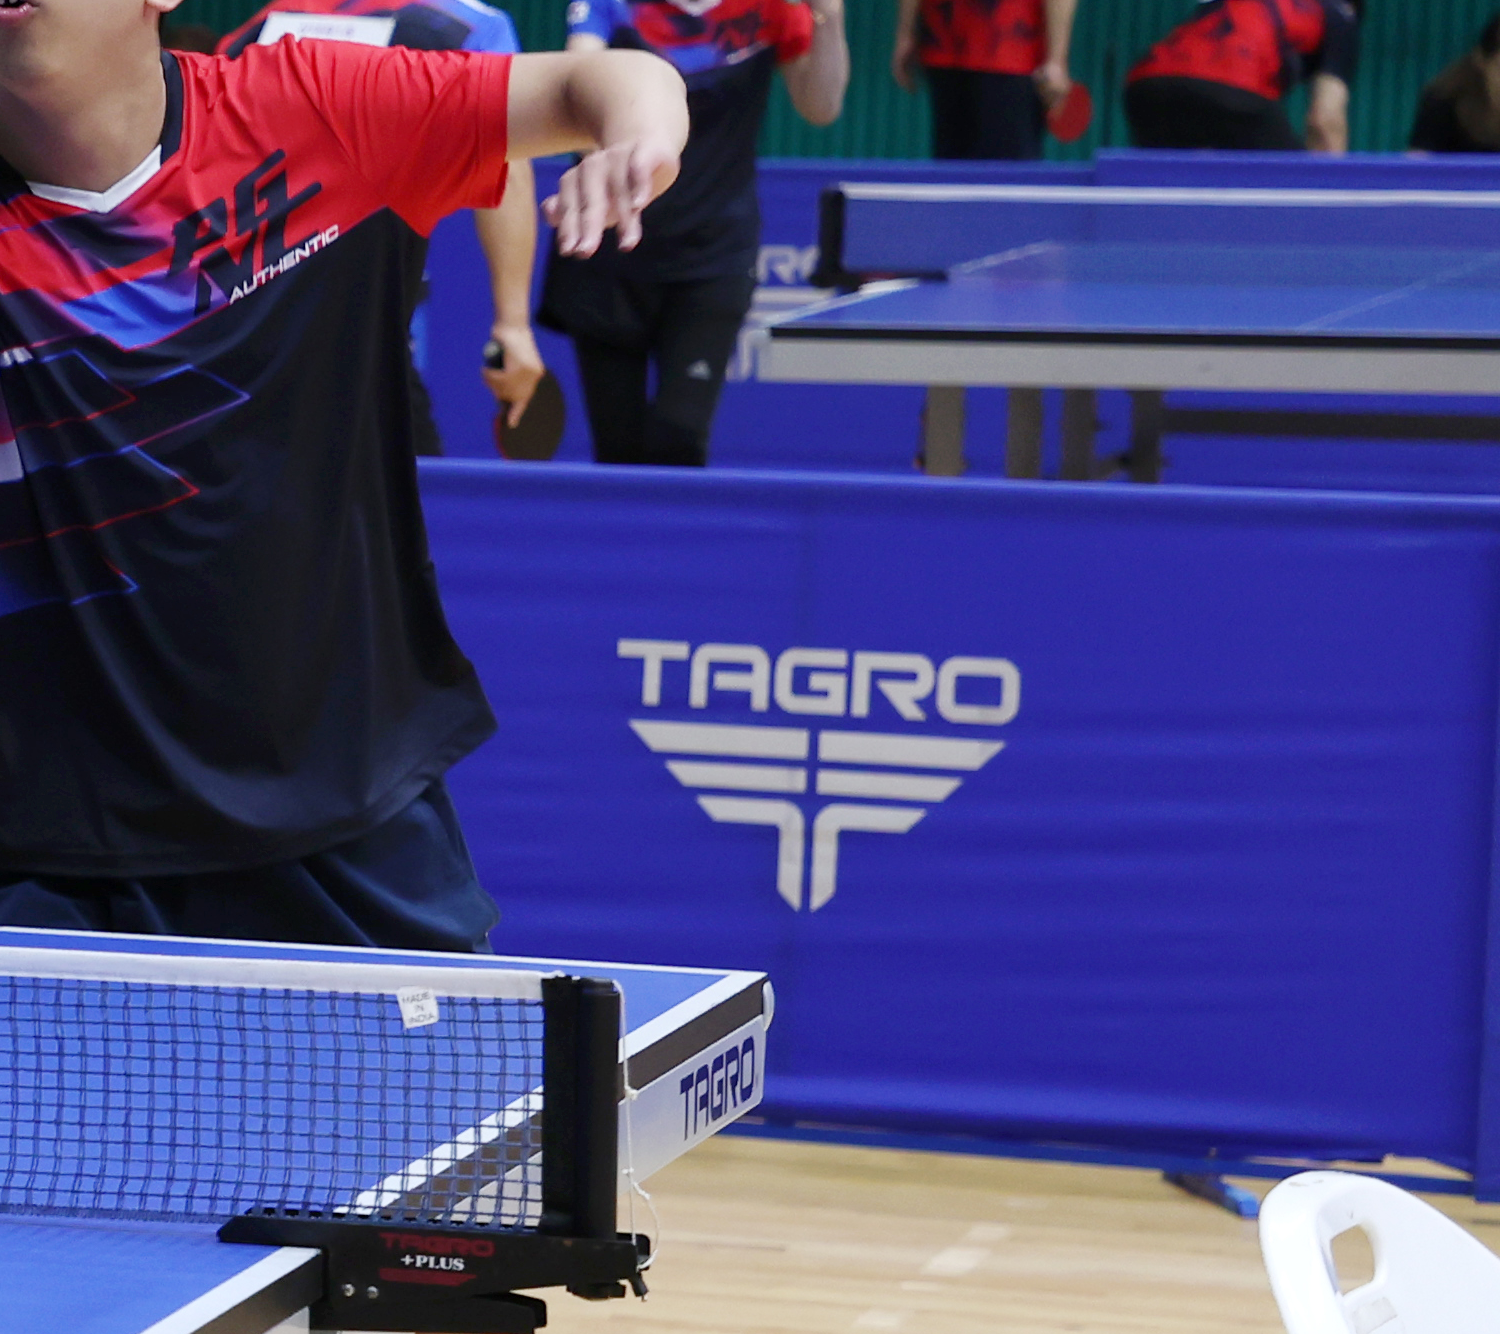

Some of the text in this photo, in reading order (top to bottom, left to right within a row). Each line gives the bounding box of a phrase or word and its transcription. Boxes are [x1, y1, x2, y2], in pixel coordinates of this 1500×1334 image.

[230, 224, 340, 306] AUTHENTIC
[616, 637, 1022, 726] TAGRO
[680, 1035, 755, 1141] TAGRO
[400, 1253, 466, 1272] +PLUS
